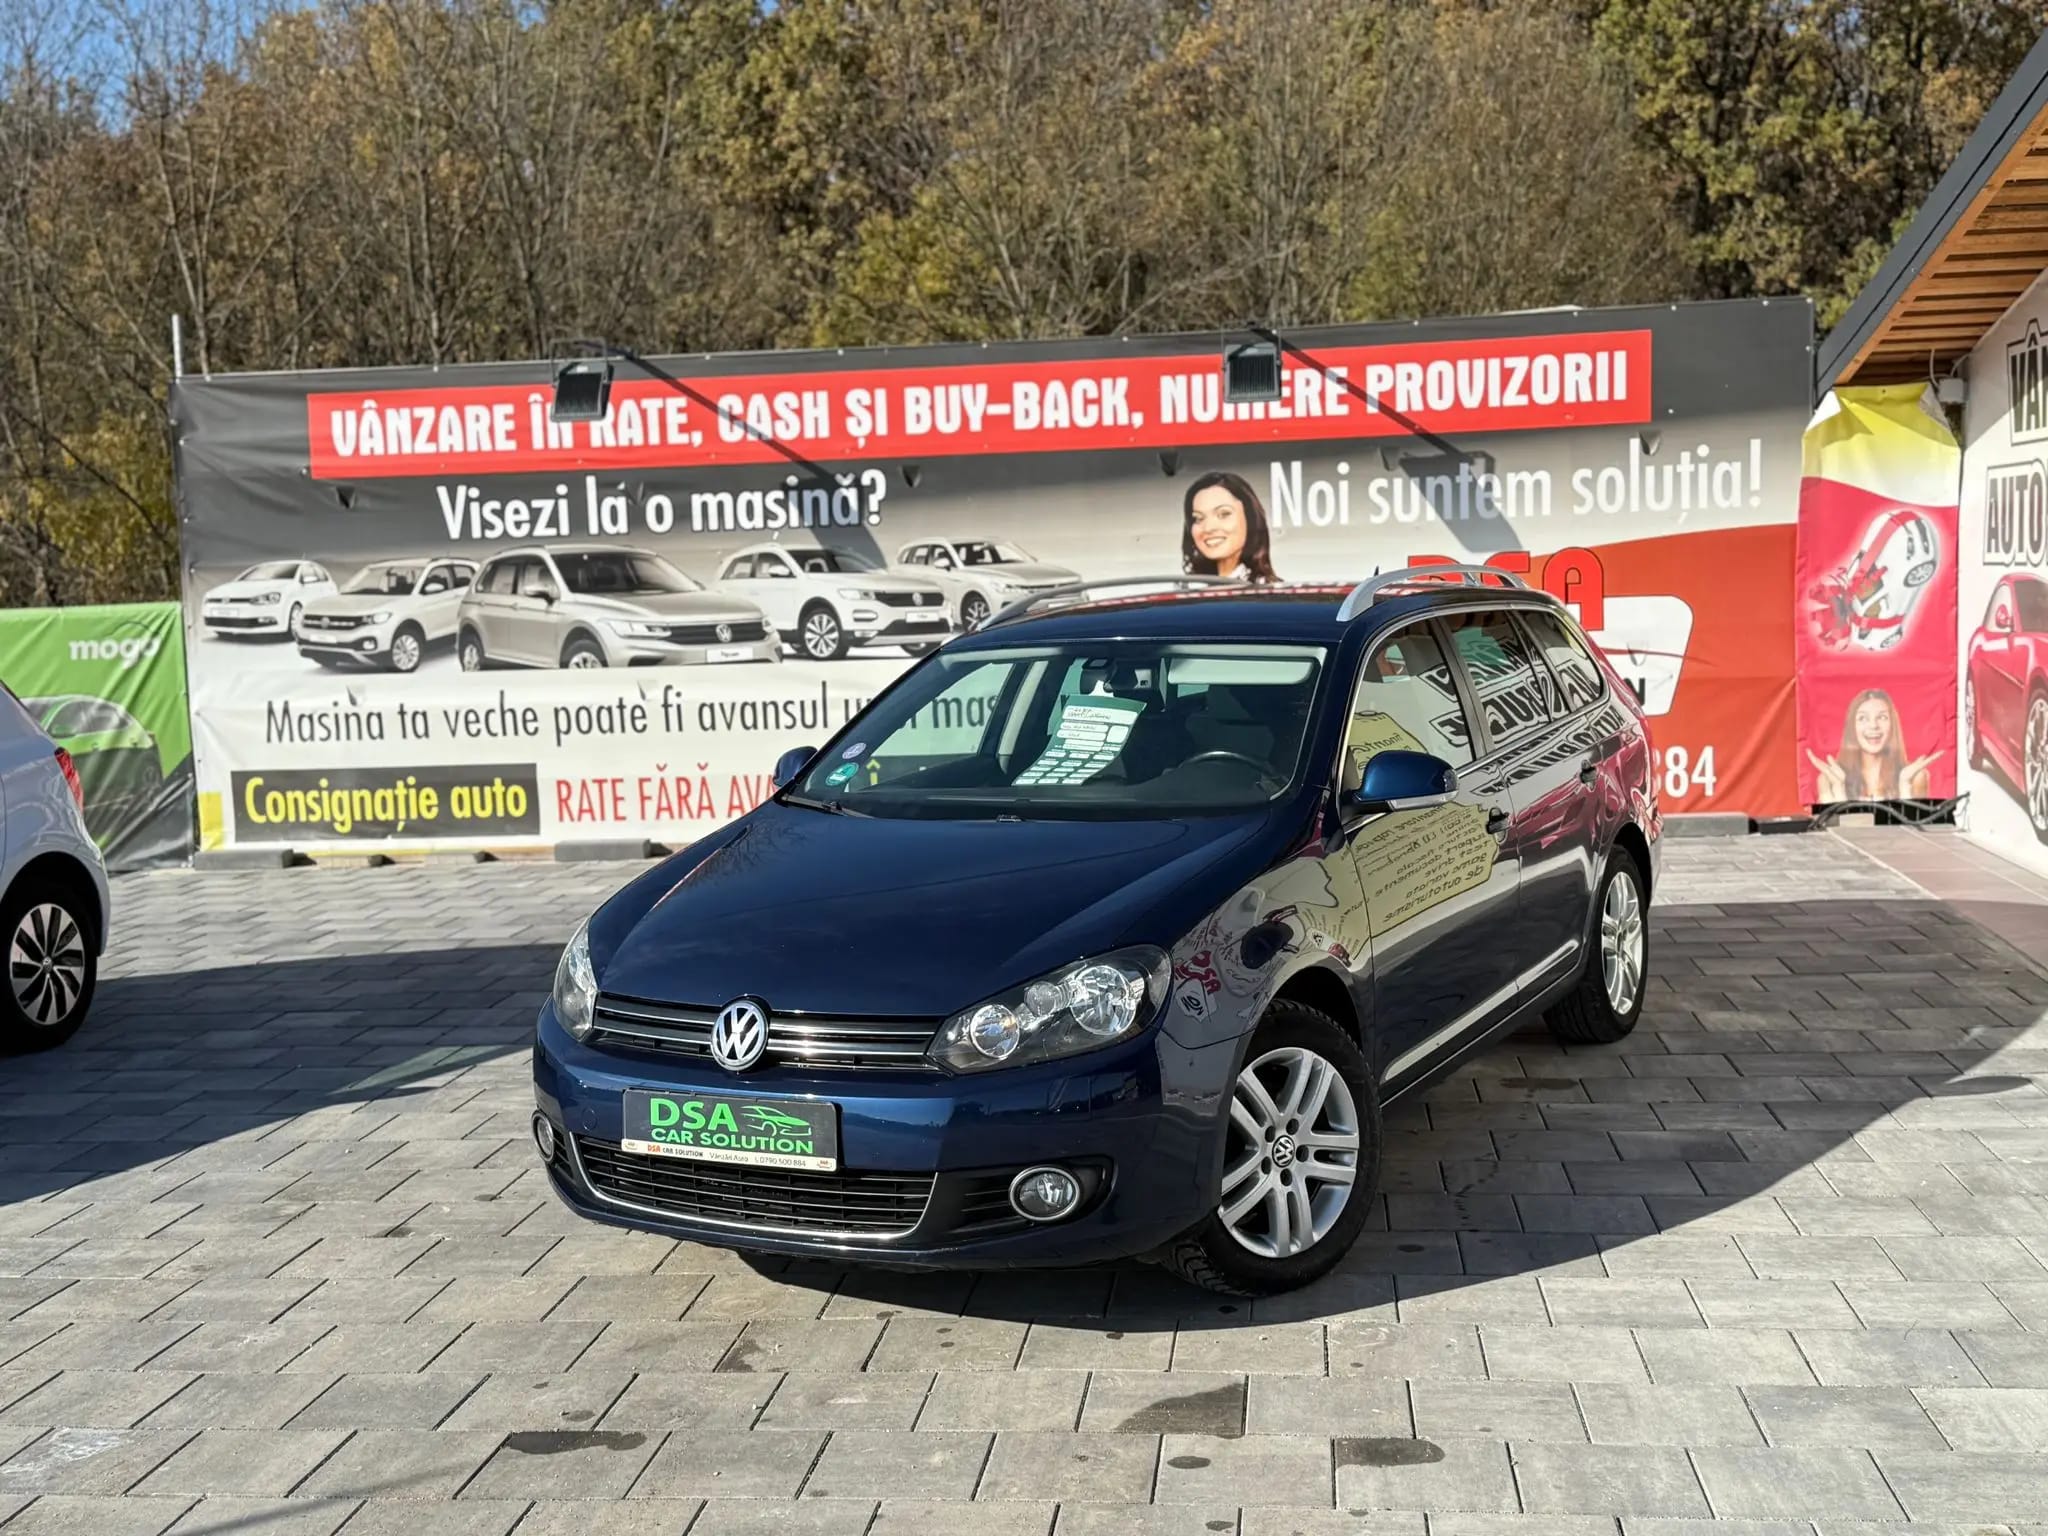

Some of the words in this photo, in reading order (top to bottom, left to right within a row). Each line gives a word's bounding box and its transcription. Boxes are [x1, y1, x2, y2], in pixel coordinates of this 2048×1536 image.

[331, 399, 517, 457] VÂNZARE
[590, 396, 703, 447] RATE,
[718, 392, 830, 444] CASH
[846, 388, 887, 449] ȘI
[905, 375, 1144, 434] BUY-BACK,
[1366, 349, 1628, 413] PROVIZORII
[435, 481, 570, 541] Visezi
[586, 475, 628, 535] la
[646, 490, 674, 532] o
[1269, 460, 1350, 526] Noi
[1370, 451, 1553, 523] suntem
[1572, 437, 1762, 518] soluția!
[265, 697, 383, 745] Masina
[397, 700, 429, 740] ta
[443, 689, 540, 739] veche
[553, 694, 647, 748] poate
[662, 685, 684, 733] fi
[698, 681, 829, 731] avansul
[556, 779, 627, 822] RATE
[638, 762, 716, 820] FĂRĂ
[1653, 745, 1717, 799] 84
[243, 774, 440, 833] Consignație
[452, 777, 527, 819] auto
[650, 1098, 739, 1132] DSA
[651, 1127, 694, 1144] CAR
[700, 1132, 813, 1154] SOLUTION
